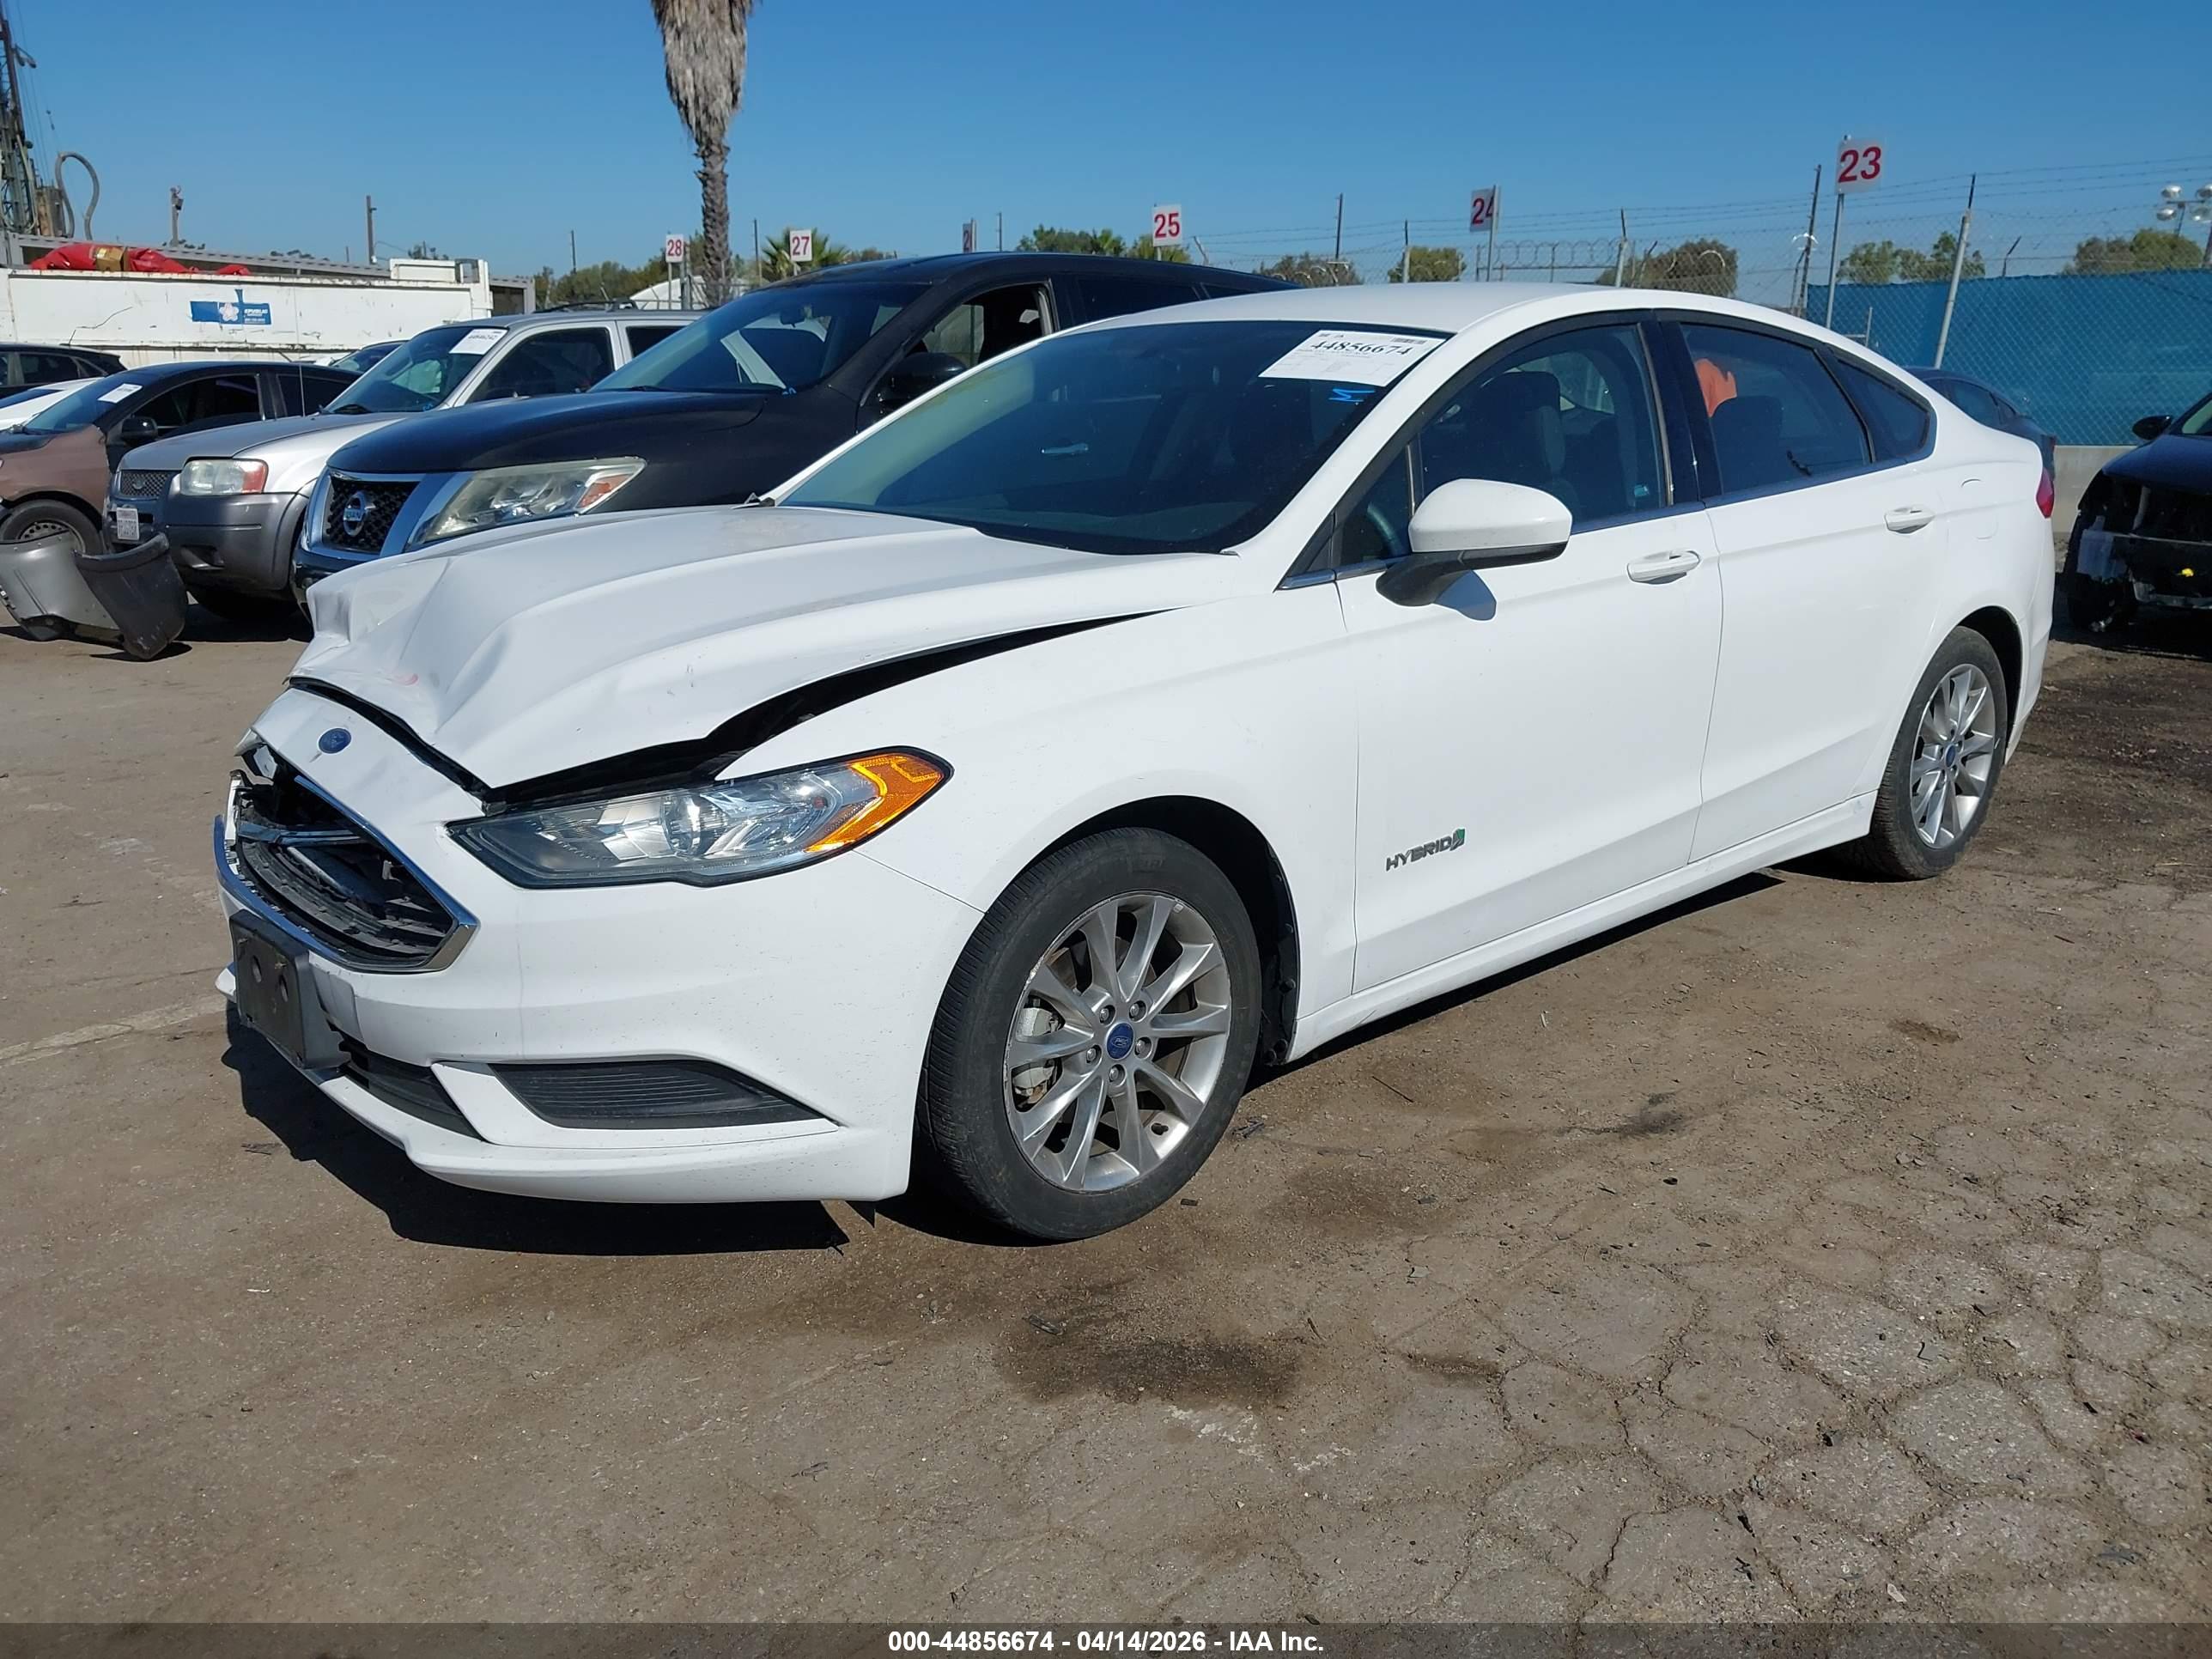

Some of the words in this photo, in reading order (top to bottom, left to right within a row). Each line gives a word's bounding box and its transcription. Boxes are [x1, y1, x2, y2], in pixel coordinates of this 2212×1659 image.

[1838, 146, 1881, 183] 23
[1154, 212, 1180, 238] 25
[667, 239, 683, 257] 28
[792, 236, 810, 256] 27
[1310, 340, 1414, 356] 44856674
[1385, 836, 1453, 872] HYBRID
